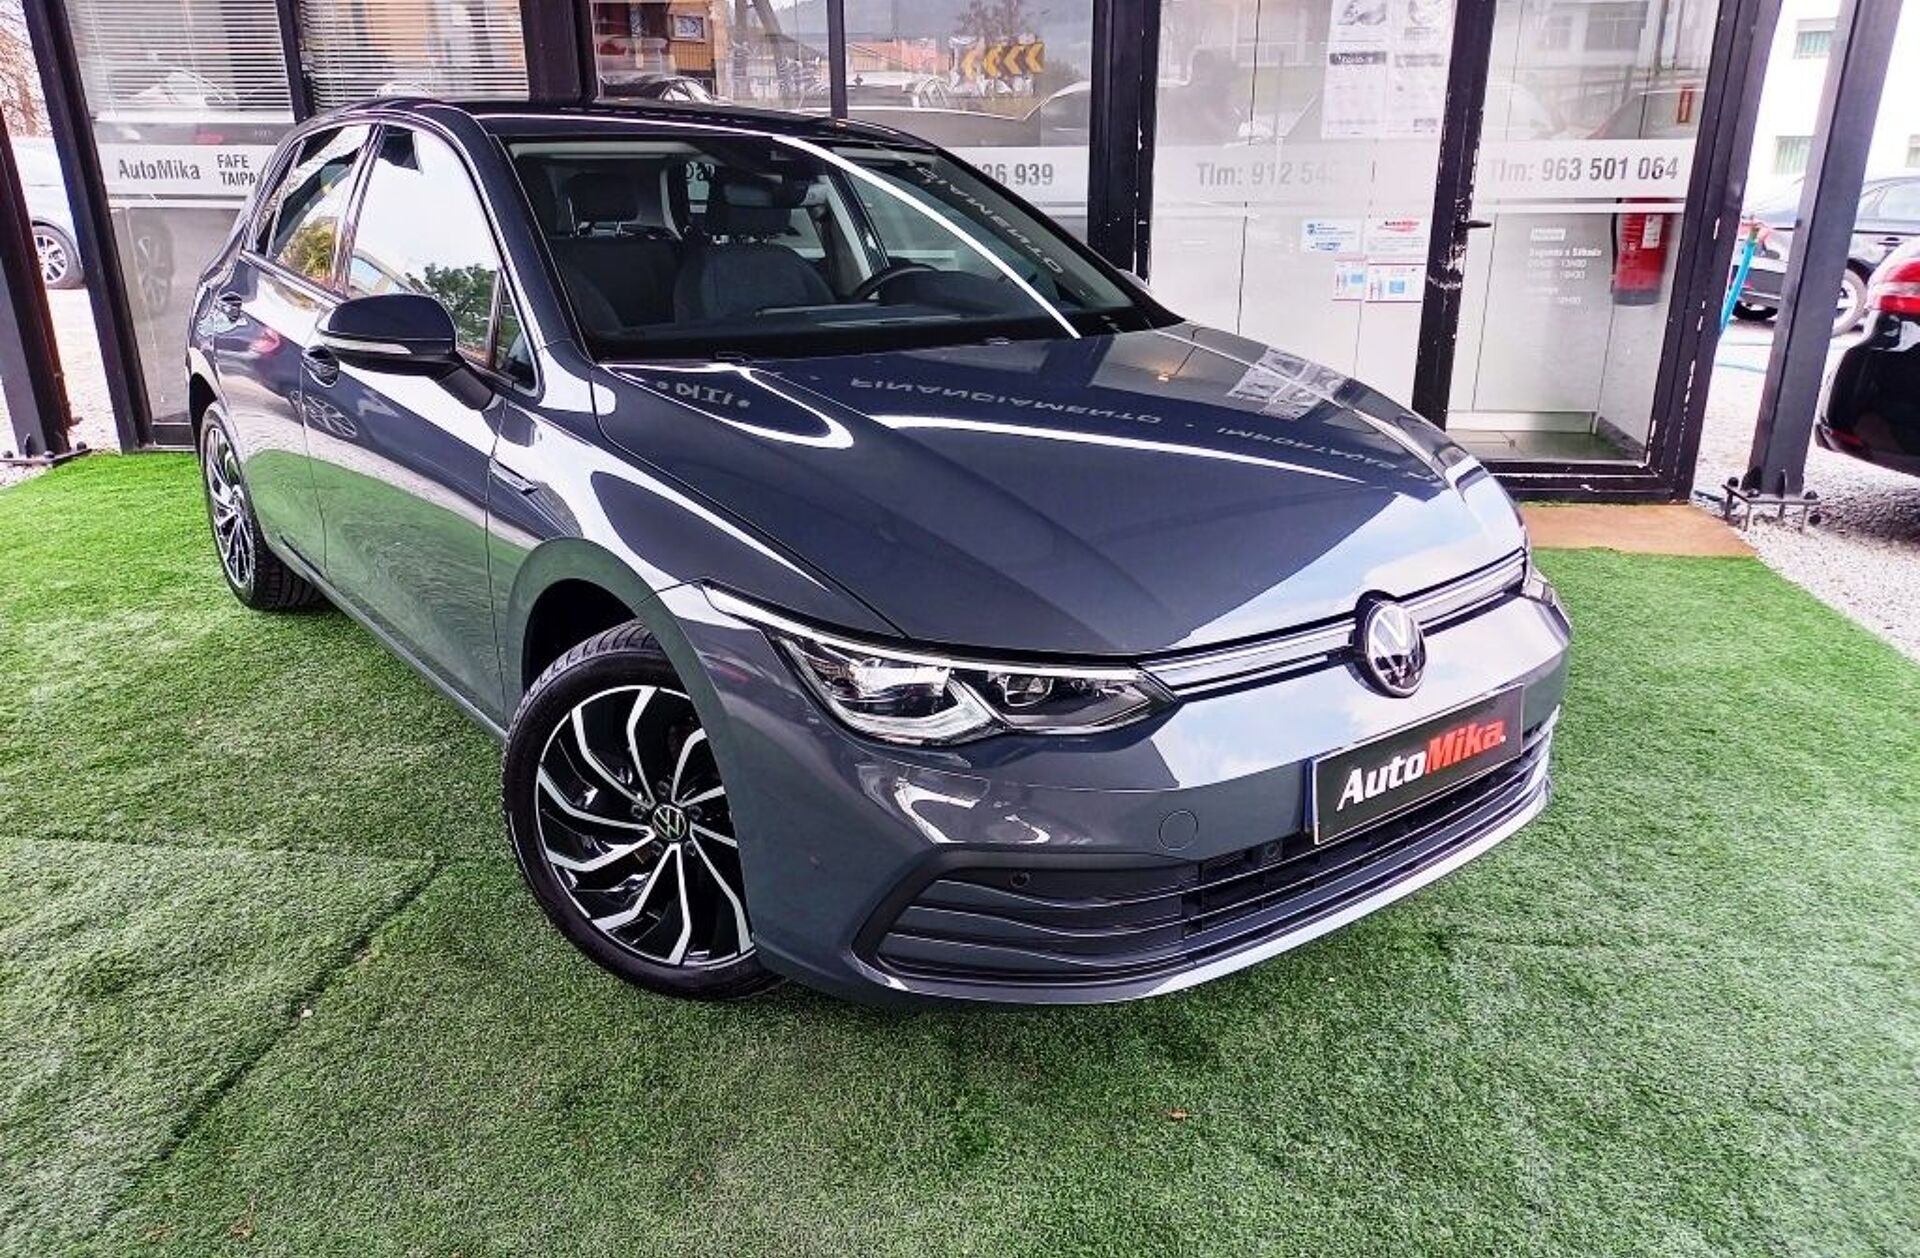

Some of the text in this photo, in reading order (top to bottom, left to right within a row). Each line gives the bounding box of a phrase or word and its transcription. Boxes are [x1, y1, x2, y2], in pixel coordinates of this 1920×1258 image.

[119, 159, 201, 181] AutoMika
[217, 153, 250, 169] FAFE
[1487, 156, 1680, 183] Tlm: 963 501 064
[219, 171, 259, 187] TAIPA
[1014, 163, 1054, 186] 939
[1196, 161, 1340, 186] Tlm: 912 54
